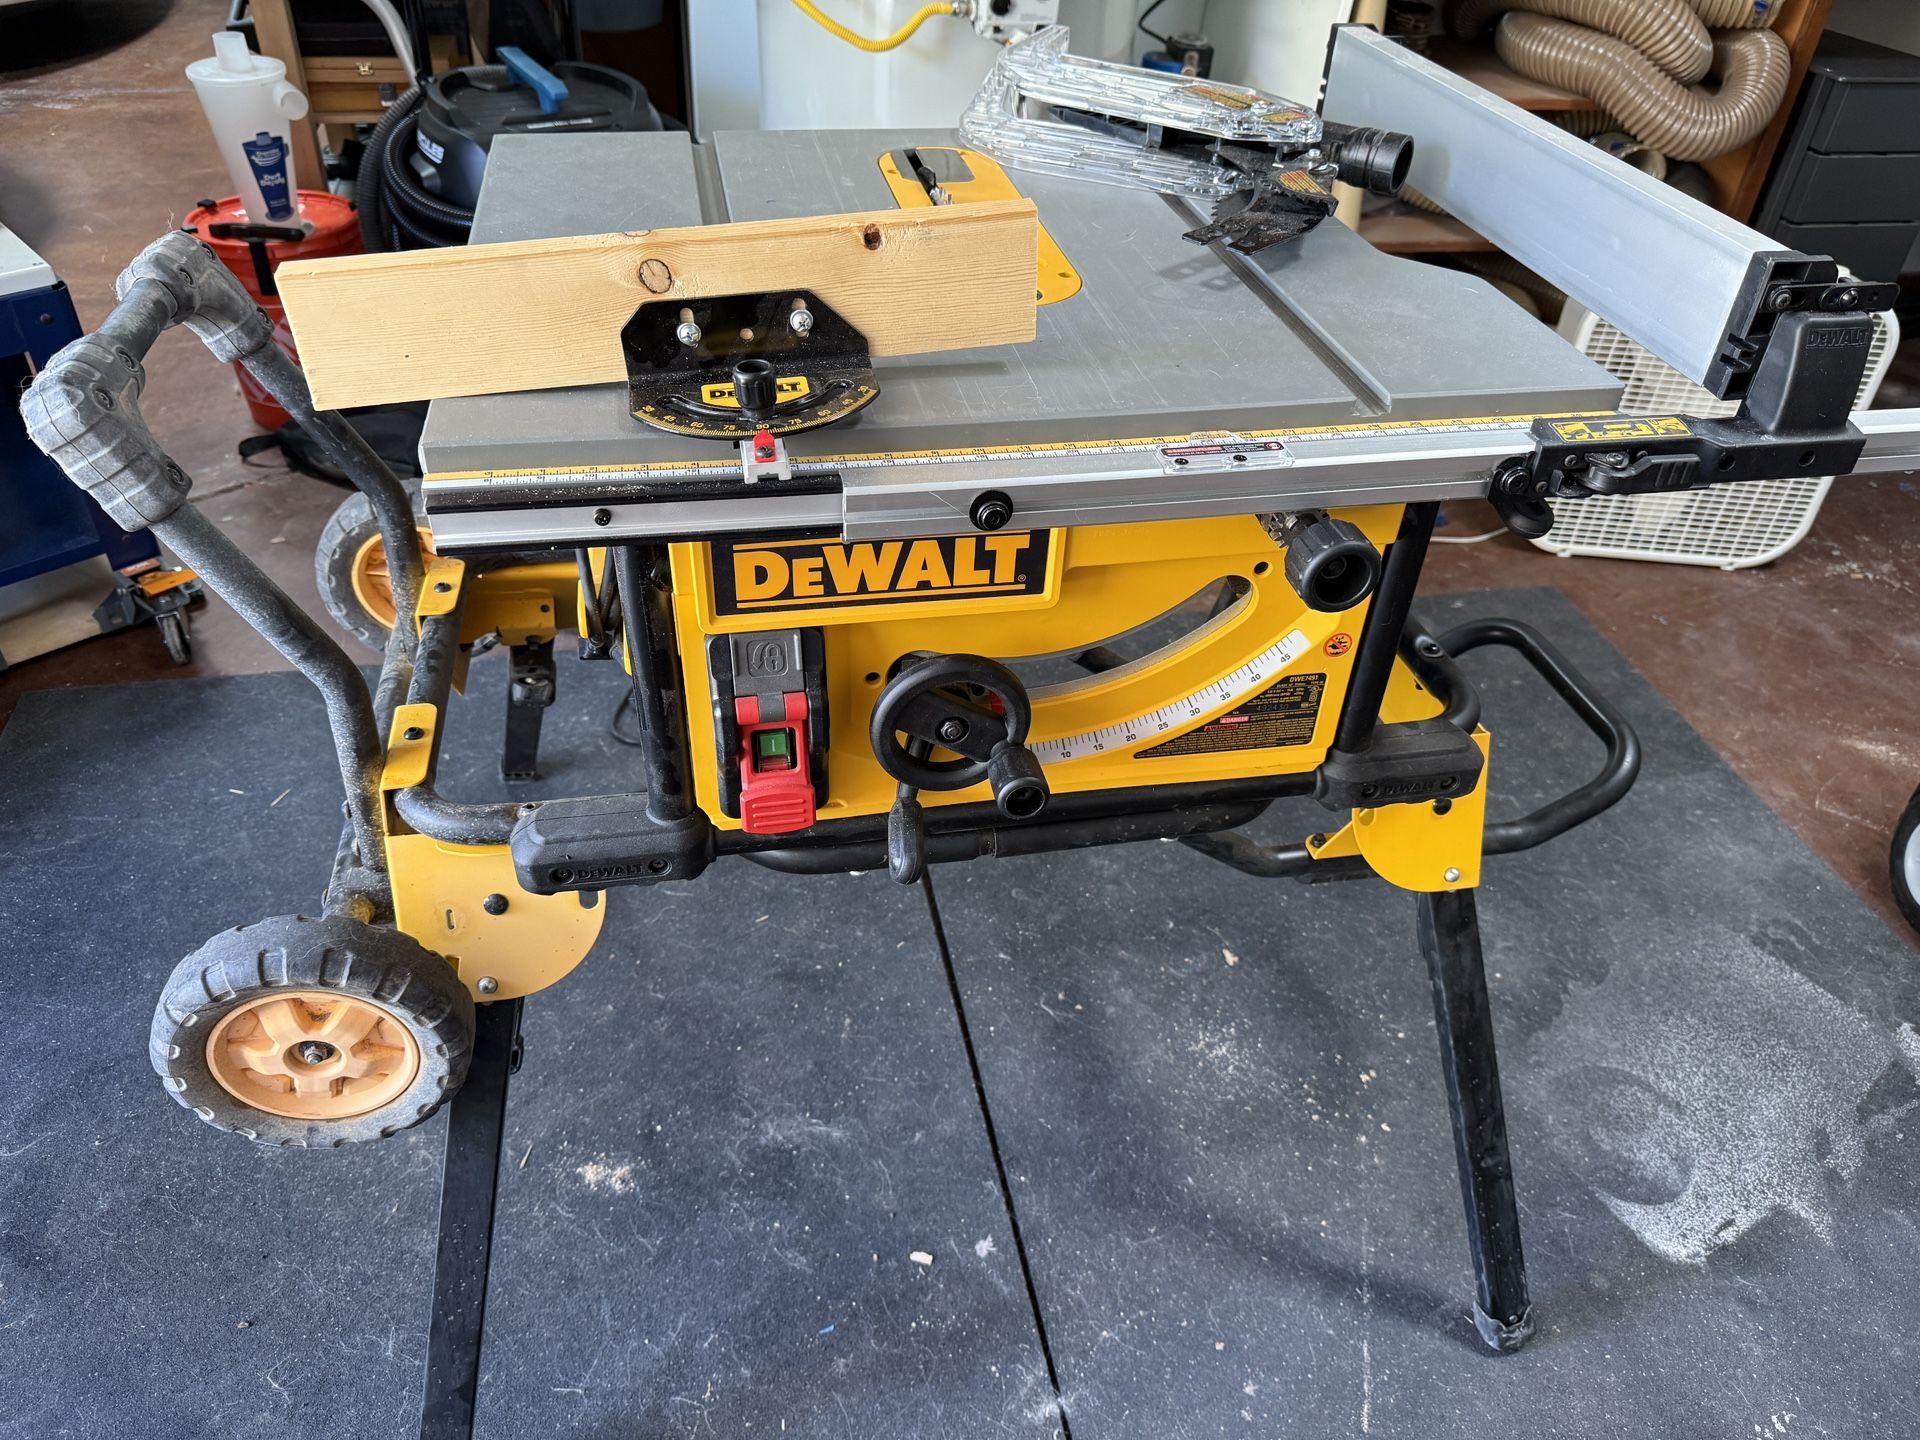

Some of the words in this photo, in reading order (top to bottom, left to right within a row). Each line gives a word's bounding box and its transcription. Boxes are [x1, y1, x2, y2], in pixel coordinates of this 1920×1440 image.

[1807, 328, 1868, 346] DEWALT
[733, 535, 1030, 600] DEWALT
[1289, 675, 1319, 683] DWE7491
[1061, 751, 1071, 759] 10
[1093, 743, 1104, 751] 15
[1126, 734, 1137, 742] 20
[1158, 722, 1169, 731] 25
[1190, 707, 1201, 716] 30
[1221, 692, 1231, 701] 35
[1251, 673, 1262, 683] 40
[1280, 653, 1291, 663] 45
[577, 864, 644, 879] DEWALT
